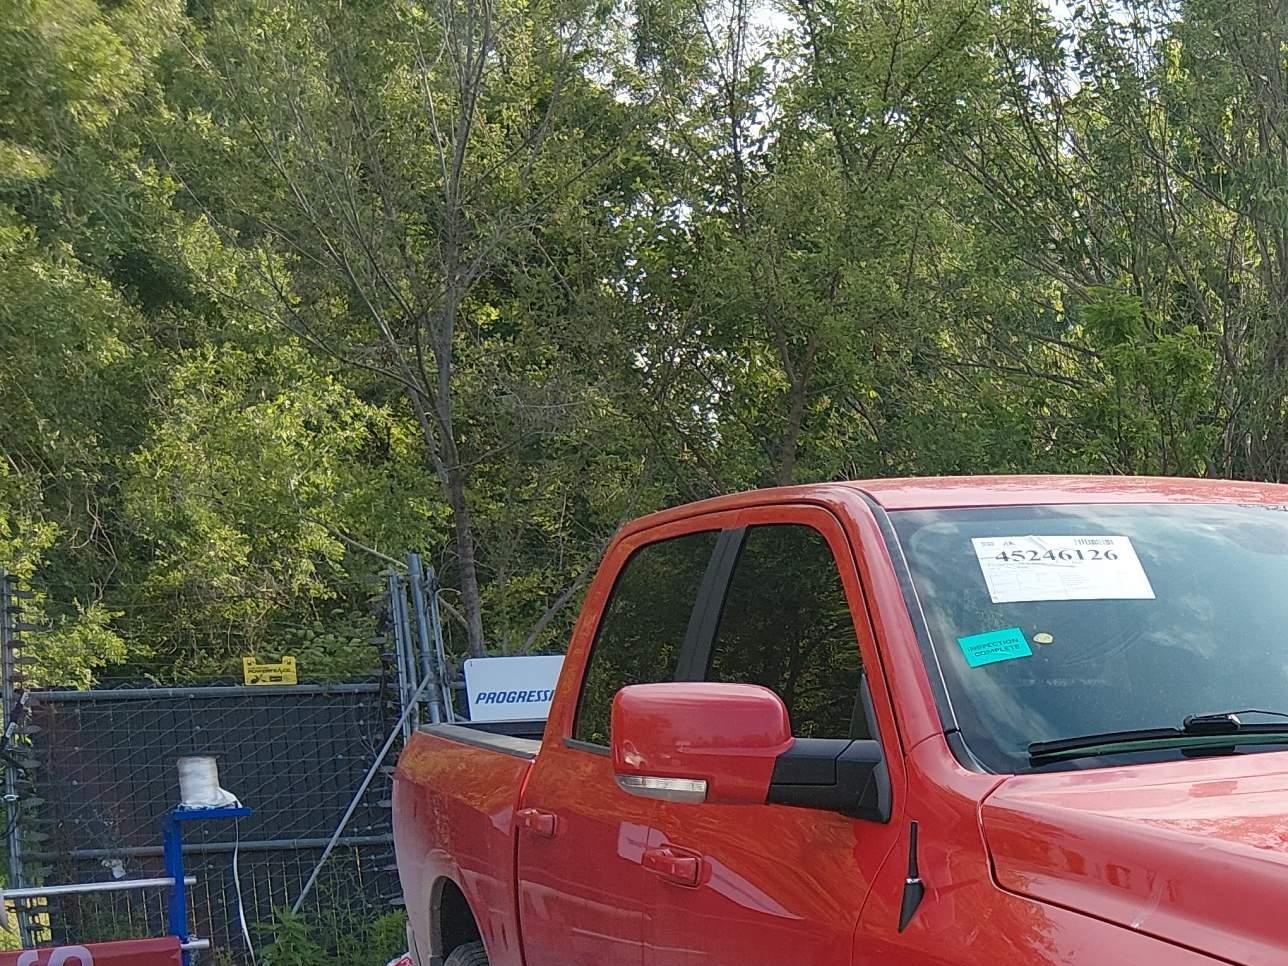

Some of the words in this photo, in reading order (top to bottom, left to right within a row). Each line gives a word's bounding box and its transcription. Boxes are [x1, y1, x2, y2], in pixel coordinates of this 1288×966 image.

[995, 548, 1119, 562] 45246126
[967, 638, 1019, 652] INSPECTION
[974, 643, 1021, 657] COMPLETE
